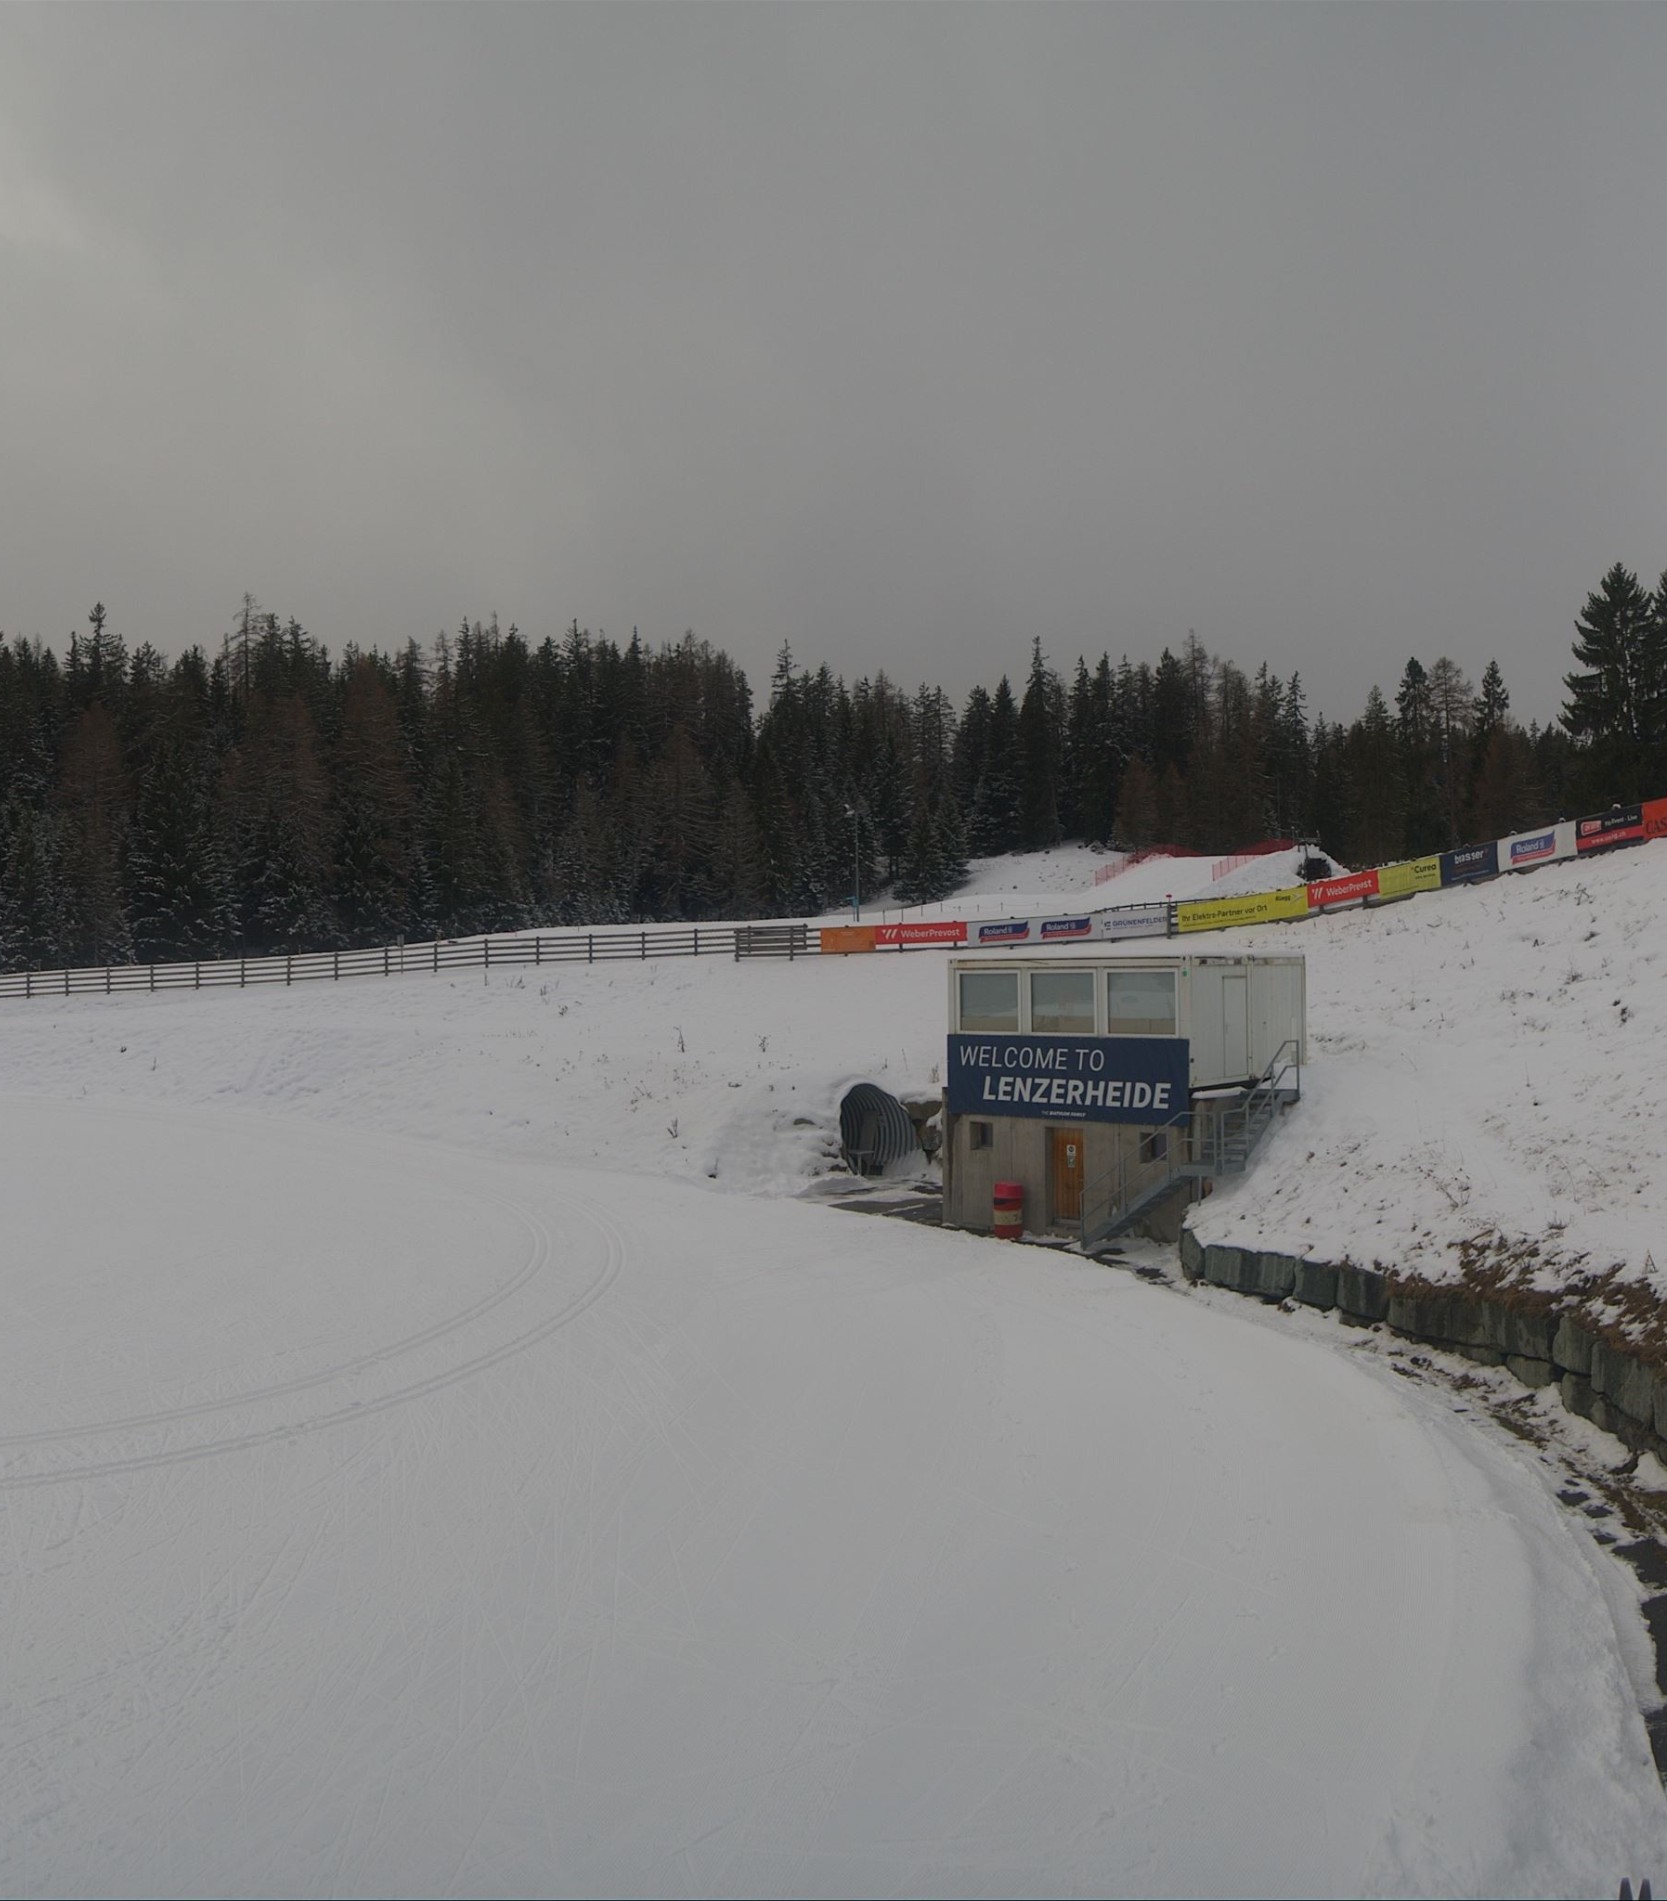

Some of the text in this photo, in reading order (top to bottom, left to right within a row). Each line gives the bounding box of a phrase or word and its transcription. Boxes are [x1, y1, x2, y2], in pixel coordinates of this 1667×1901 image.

[1257, 904, 1268, 912] Ort
[983, 927, 1008, 935] Roland
[1046, 923, 1070, 931] Roland
[901, 928, 960, 939] WeberPrevost
[959, 1045, 1105, 1072] WELCOME TO
[982, 1075, 1172, 1110] LENZERHEIDE
